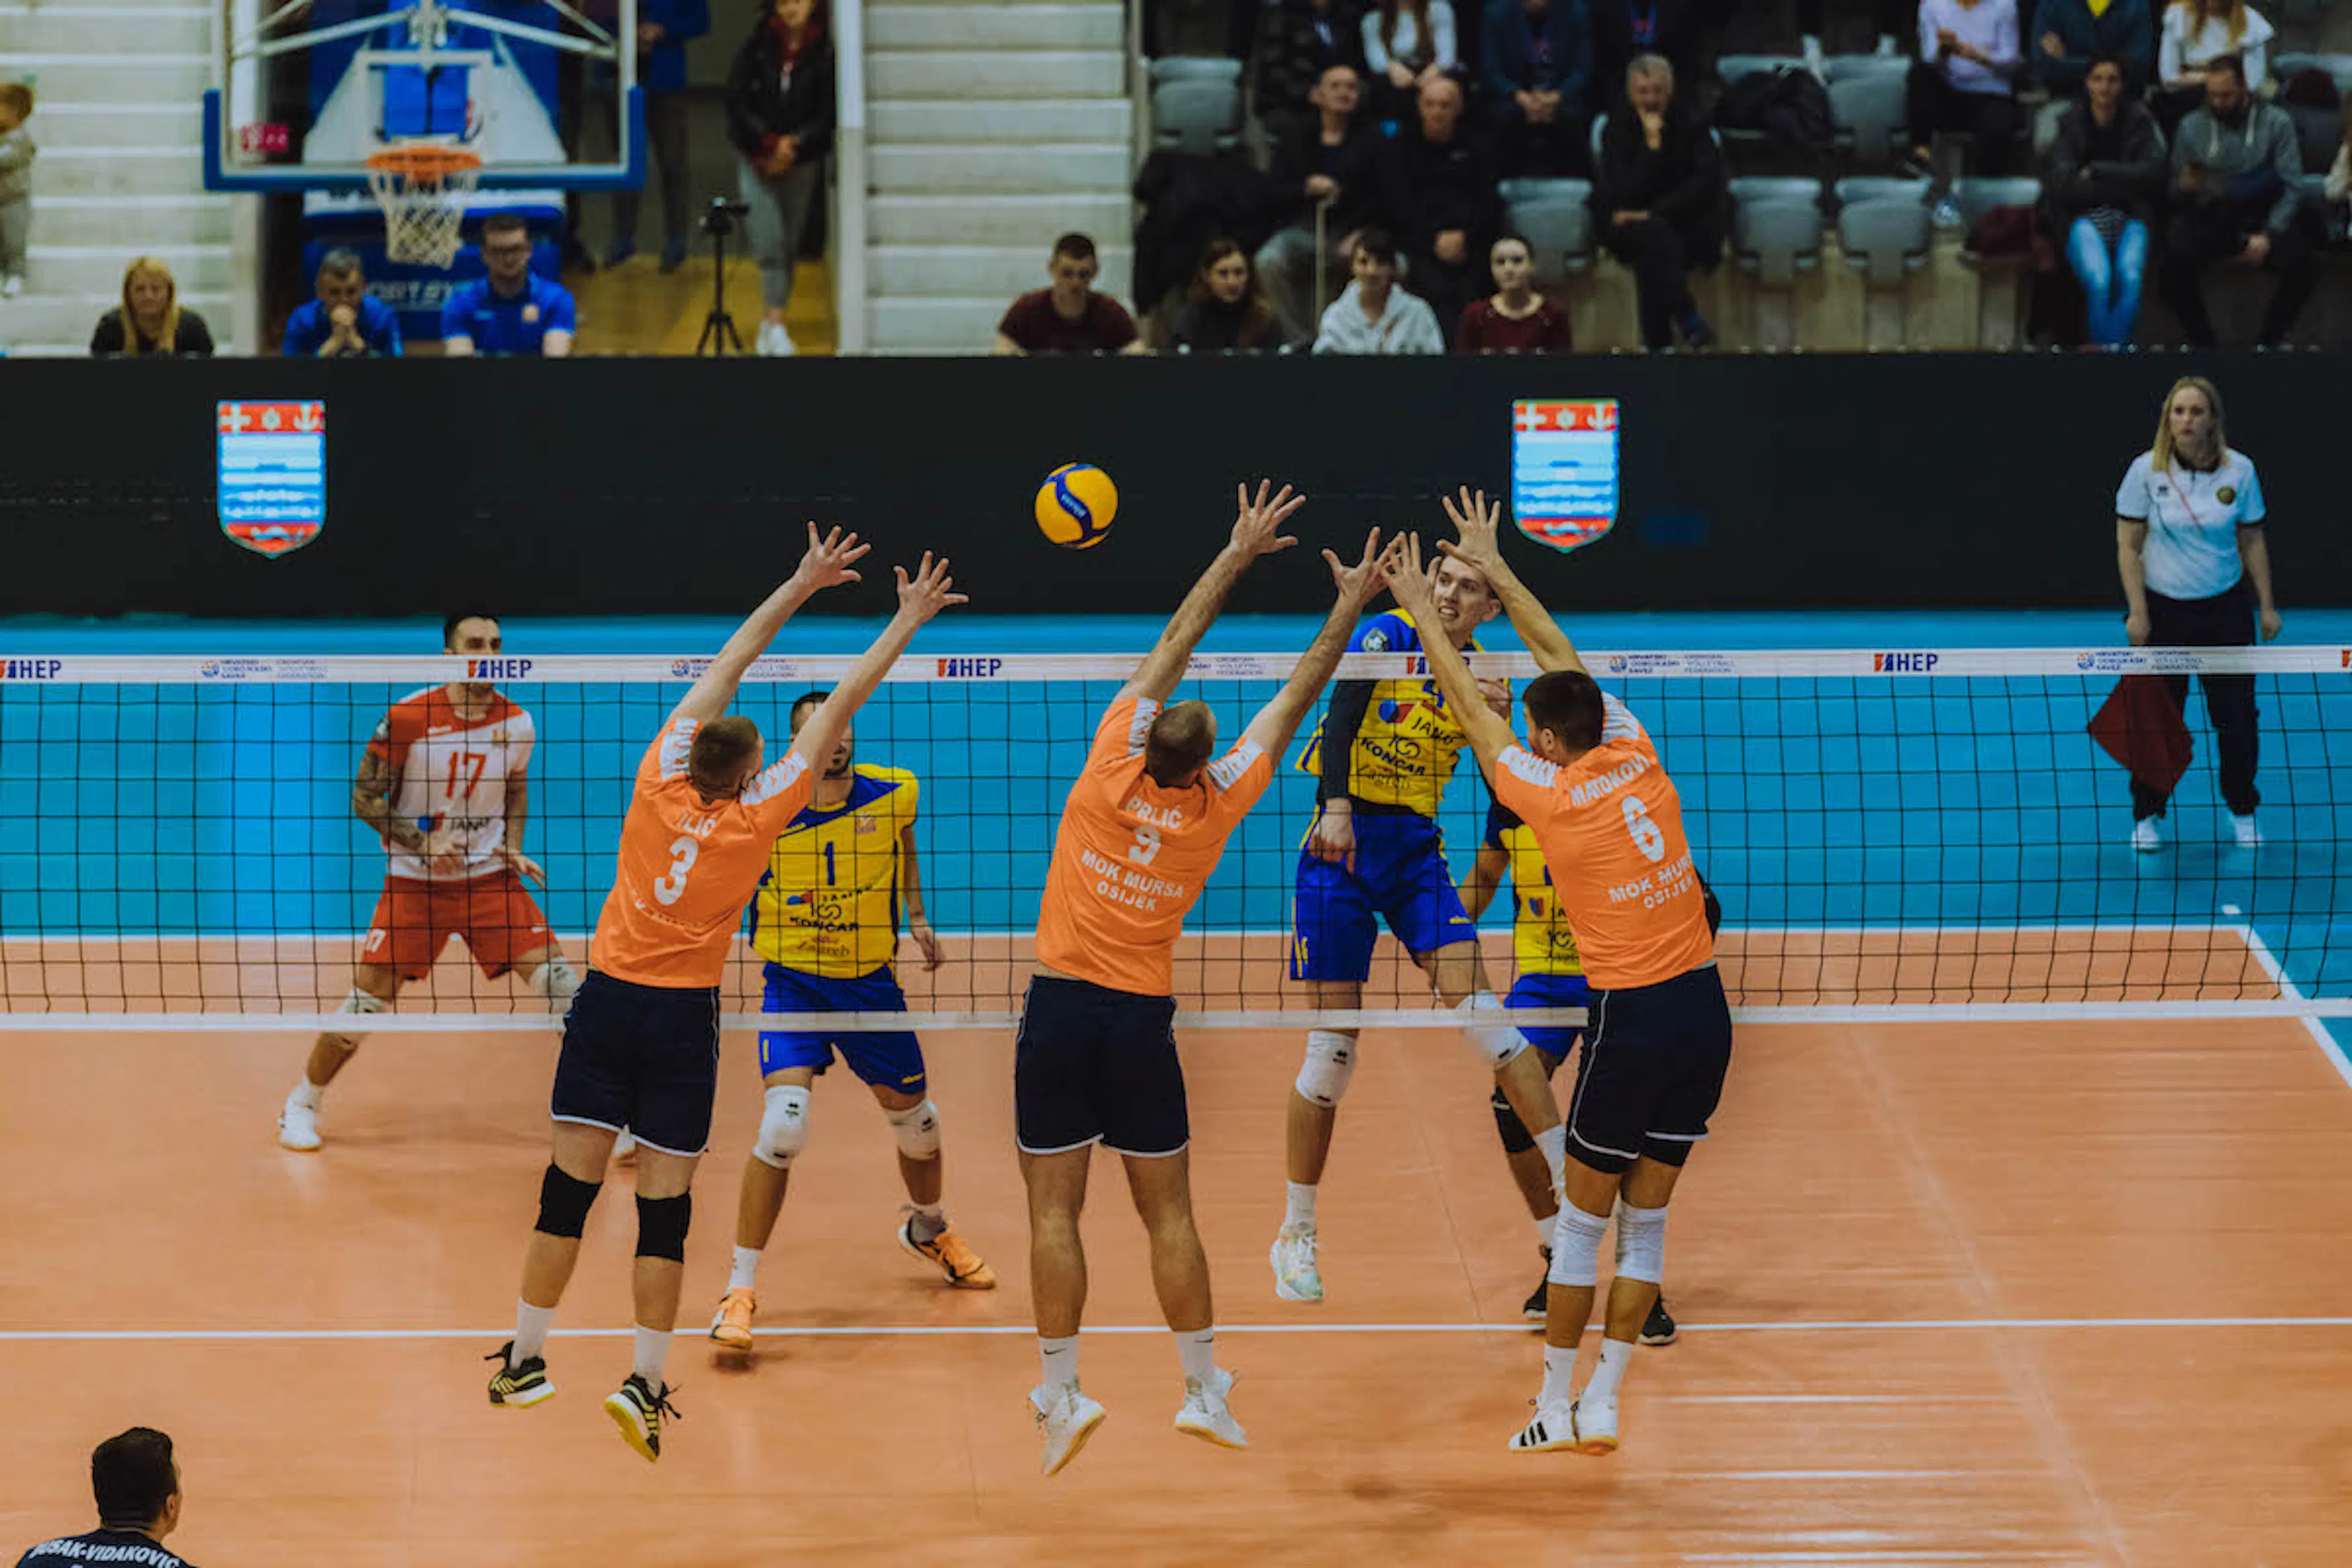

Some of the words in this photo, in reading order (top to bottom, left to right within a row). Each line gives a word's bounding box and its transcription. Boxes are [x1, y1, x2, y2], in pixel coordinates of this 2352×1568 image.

[20, 660, 61, 678] HEP
[491, 659, 532, 678] HEP
[960, 658, 1001, 676] HEP
[1897, 654, 1938, 671] HEP
[447, 752, 486, 799] 17
[1126, 795, 1182, 829] PRLIĆ
[1622, 795, 1665, 862] 6
[1128, 824, 1161, 866] 9
[654, 835, 699, 905] 3
[824, 842, 835, 886] 1
[1081, 849, 1121, 881] MOK
[1123, 871, 1183, 898] MURSA
[1097, 881, 1158, 911] OSIJEK
[1608, 877, 1653, 903] MOK
